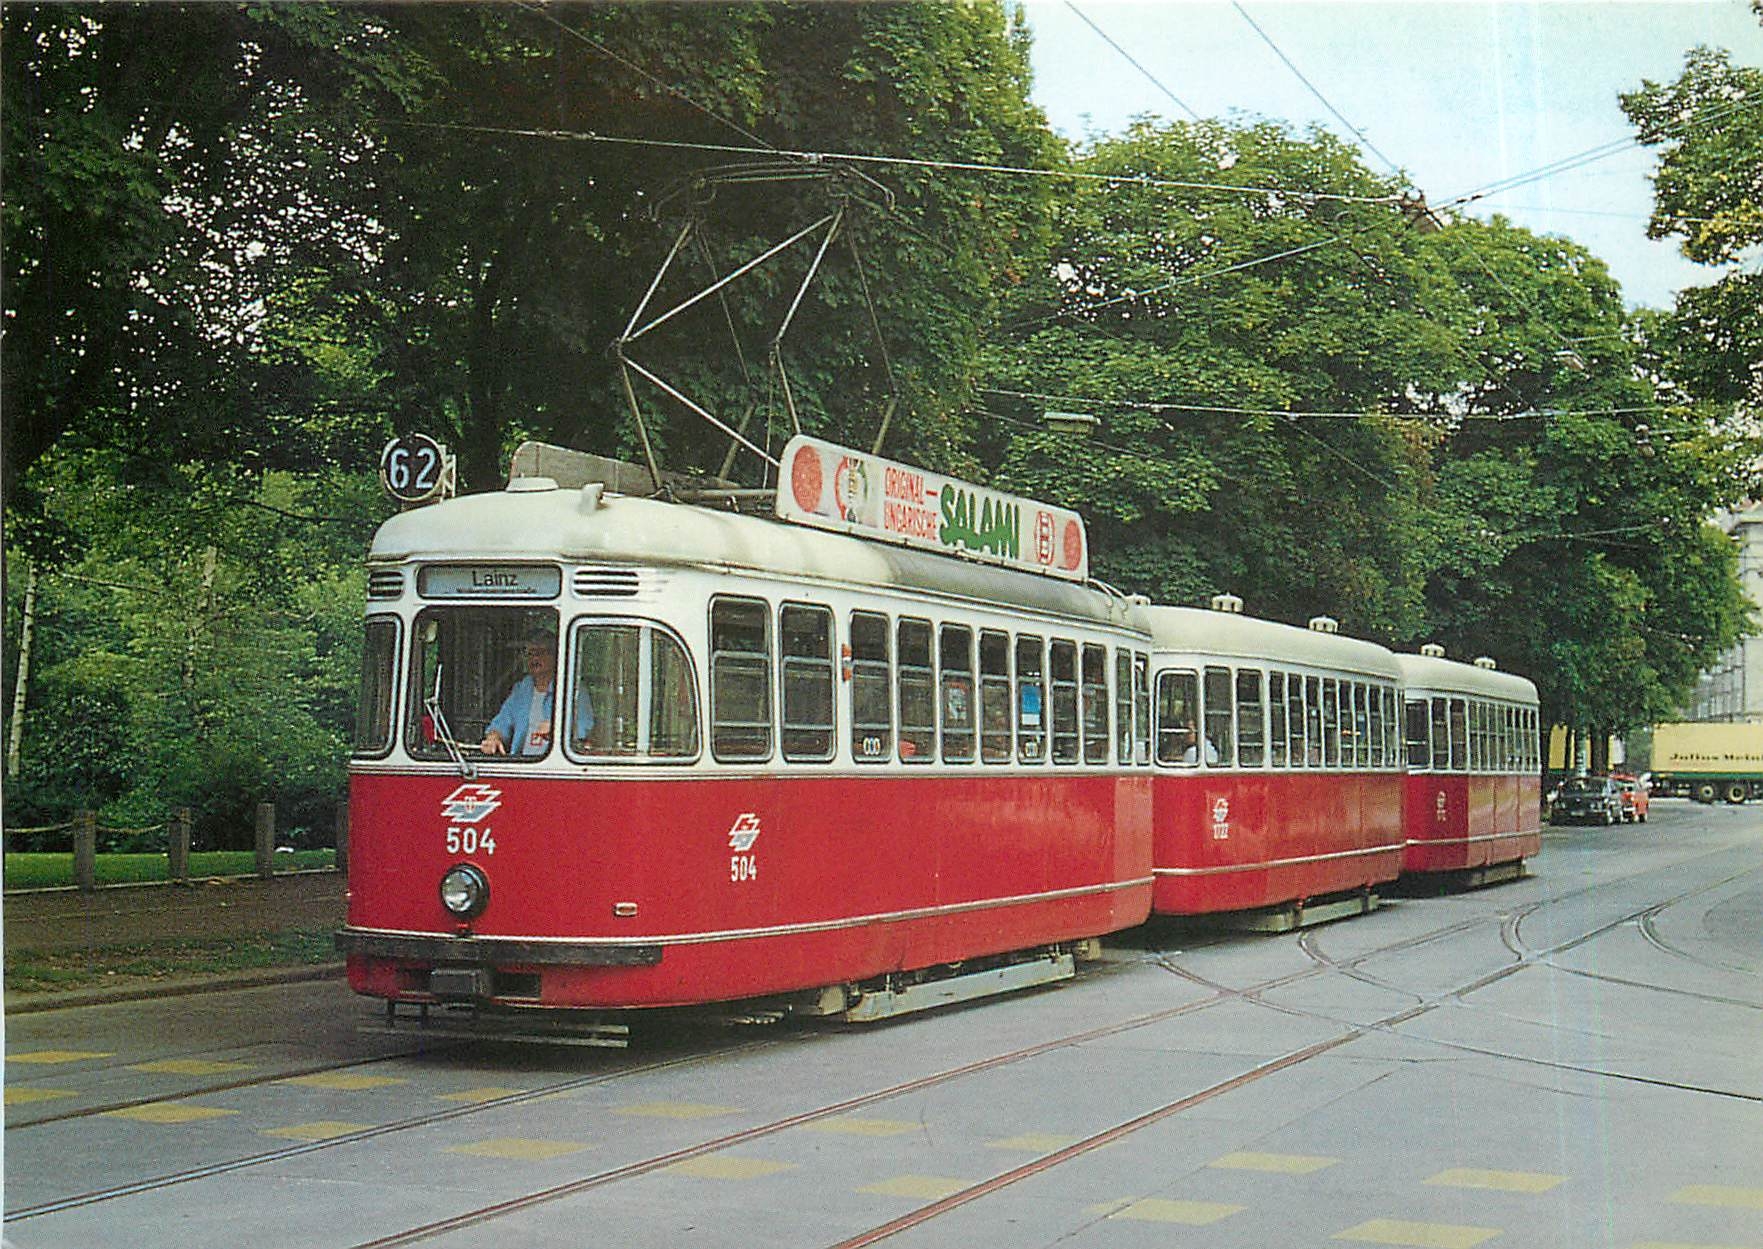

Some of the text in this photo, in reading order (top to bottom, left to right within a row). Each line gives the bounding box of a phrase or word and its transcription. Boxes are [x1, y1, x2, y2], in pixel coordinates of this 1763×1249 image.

[390, 447, 436, 490] 62
[940, 483, 1020, 560] SALAMI
[472, 570, 519, 587] Lainz
[446, 826, 497, 856] 504
[731, 854, 757, 882] 504
